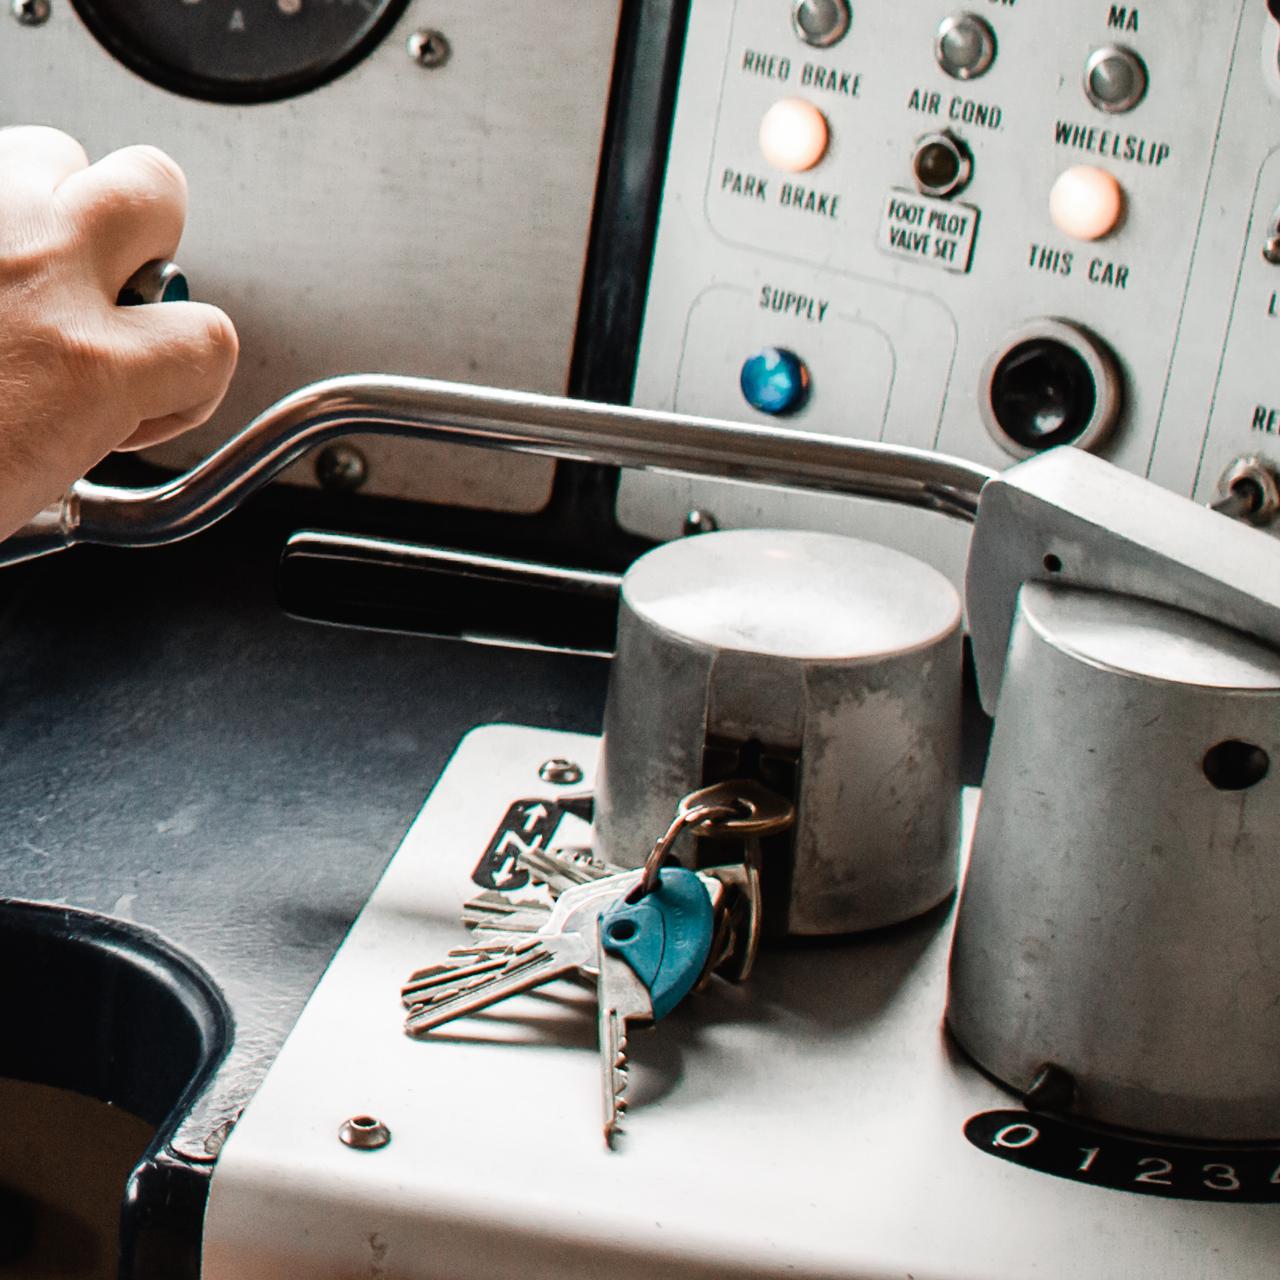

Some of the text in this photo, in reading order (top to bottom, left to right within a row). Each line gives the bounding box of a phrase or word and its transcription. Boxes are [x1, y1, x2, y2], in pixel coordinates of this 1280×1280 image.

[1107, 6, 1139, 32] MA
[801, 62, 862, 98] BRAKE
[908, 89, 939, 115] AIR
[1054, 120, 1170, 166] WHEELSLIP
[721, 169, 841, 220] PARK BRAKE
[888, 199, 968, 236] FOOT PILOT
[890, 225, 930, 254] VALVE
[1029, 243, 1130, 290] THIS CAR
[759, 284, 829, 323] SUPPLY
[1078, 1147, 1100, 1171] 1
[1135, 1157, 1172, 1185] 2
[1203, 1163, 1240, 1191] 3
